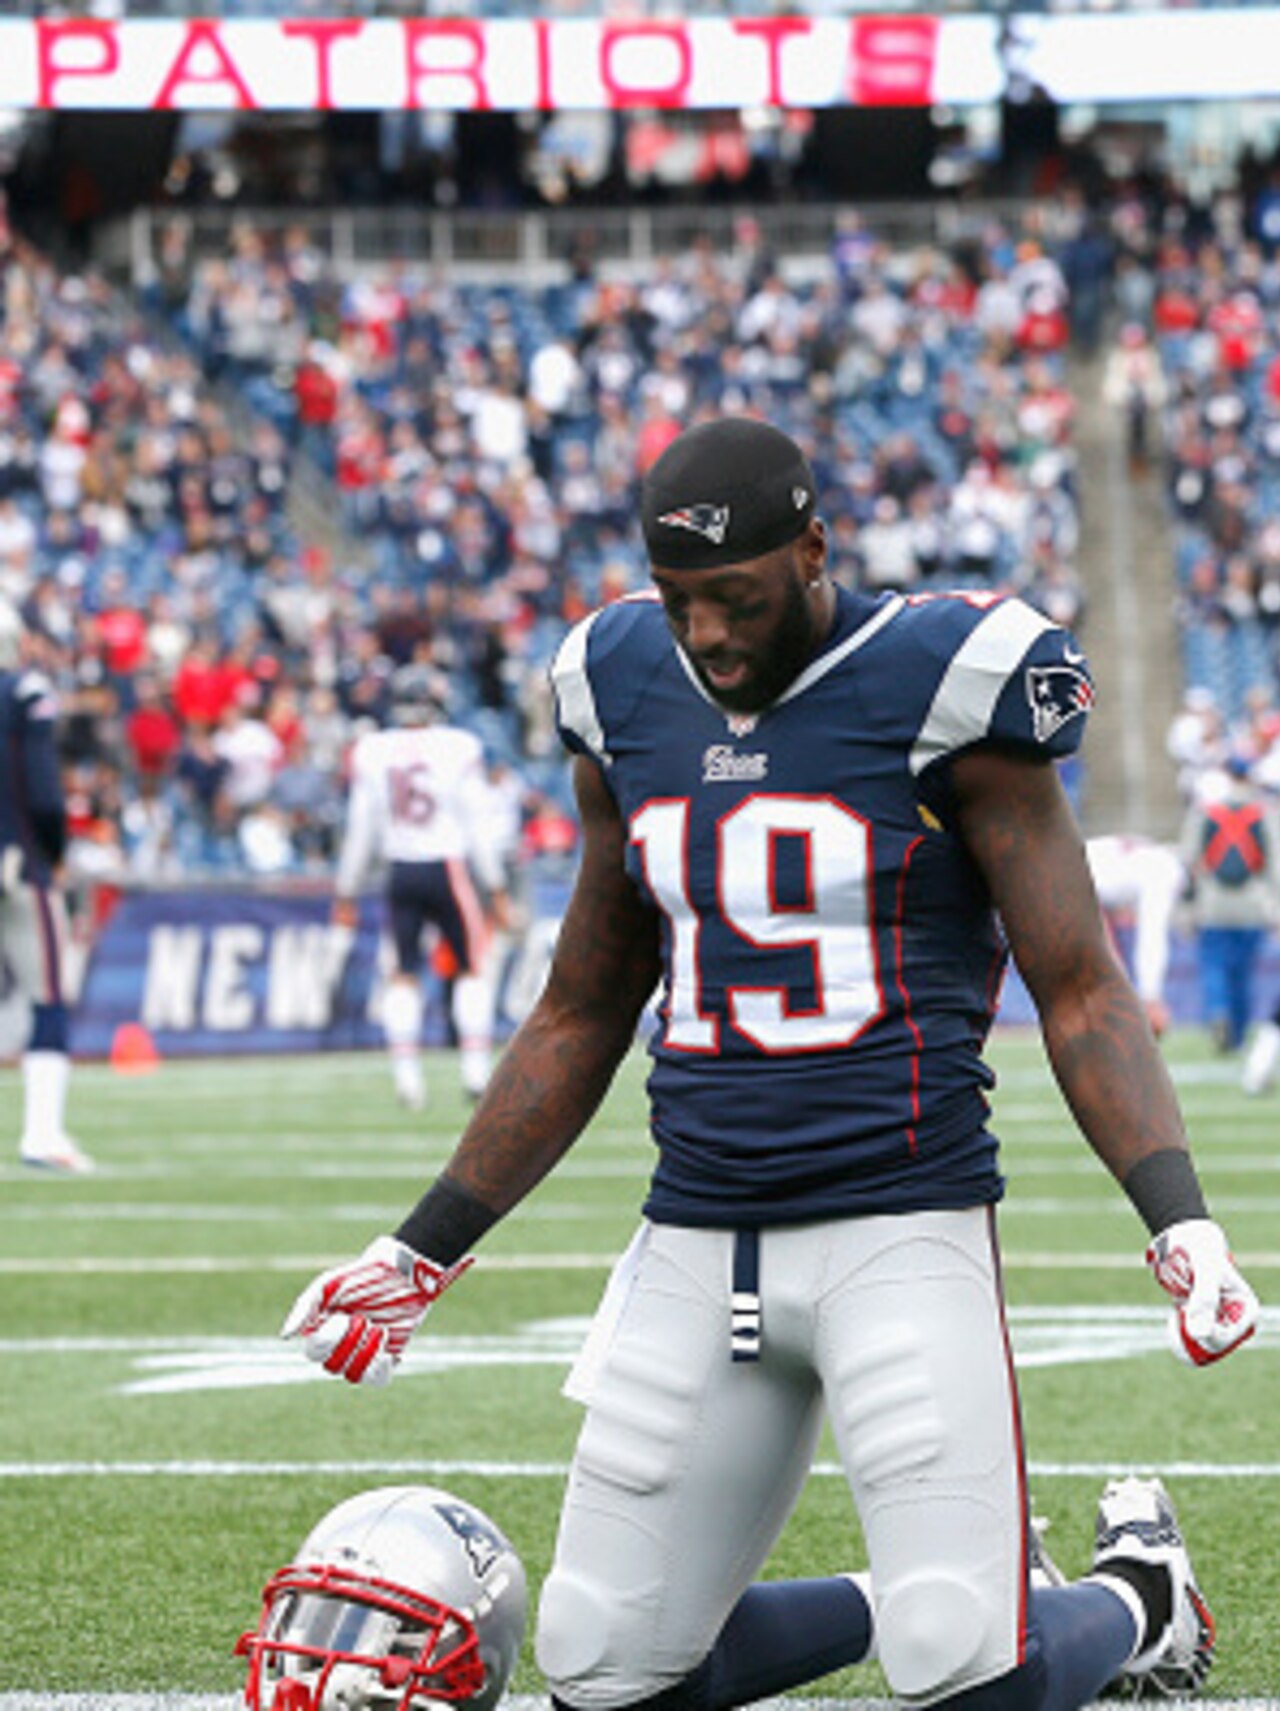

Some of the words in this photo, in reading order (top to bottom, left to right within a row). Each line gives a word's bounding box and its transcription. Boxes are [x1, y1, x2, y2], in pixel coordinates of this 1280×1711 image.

[35, 16, 940, 108] PATRIOTS
[140, 922, 356, 1031] NEW
[629, 792, 886, 1056] 19
